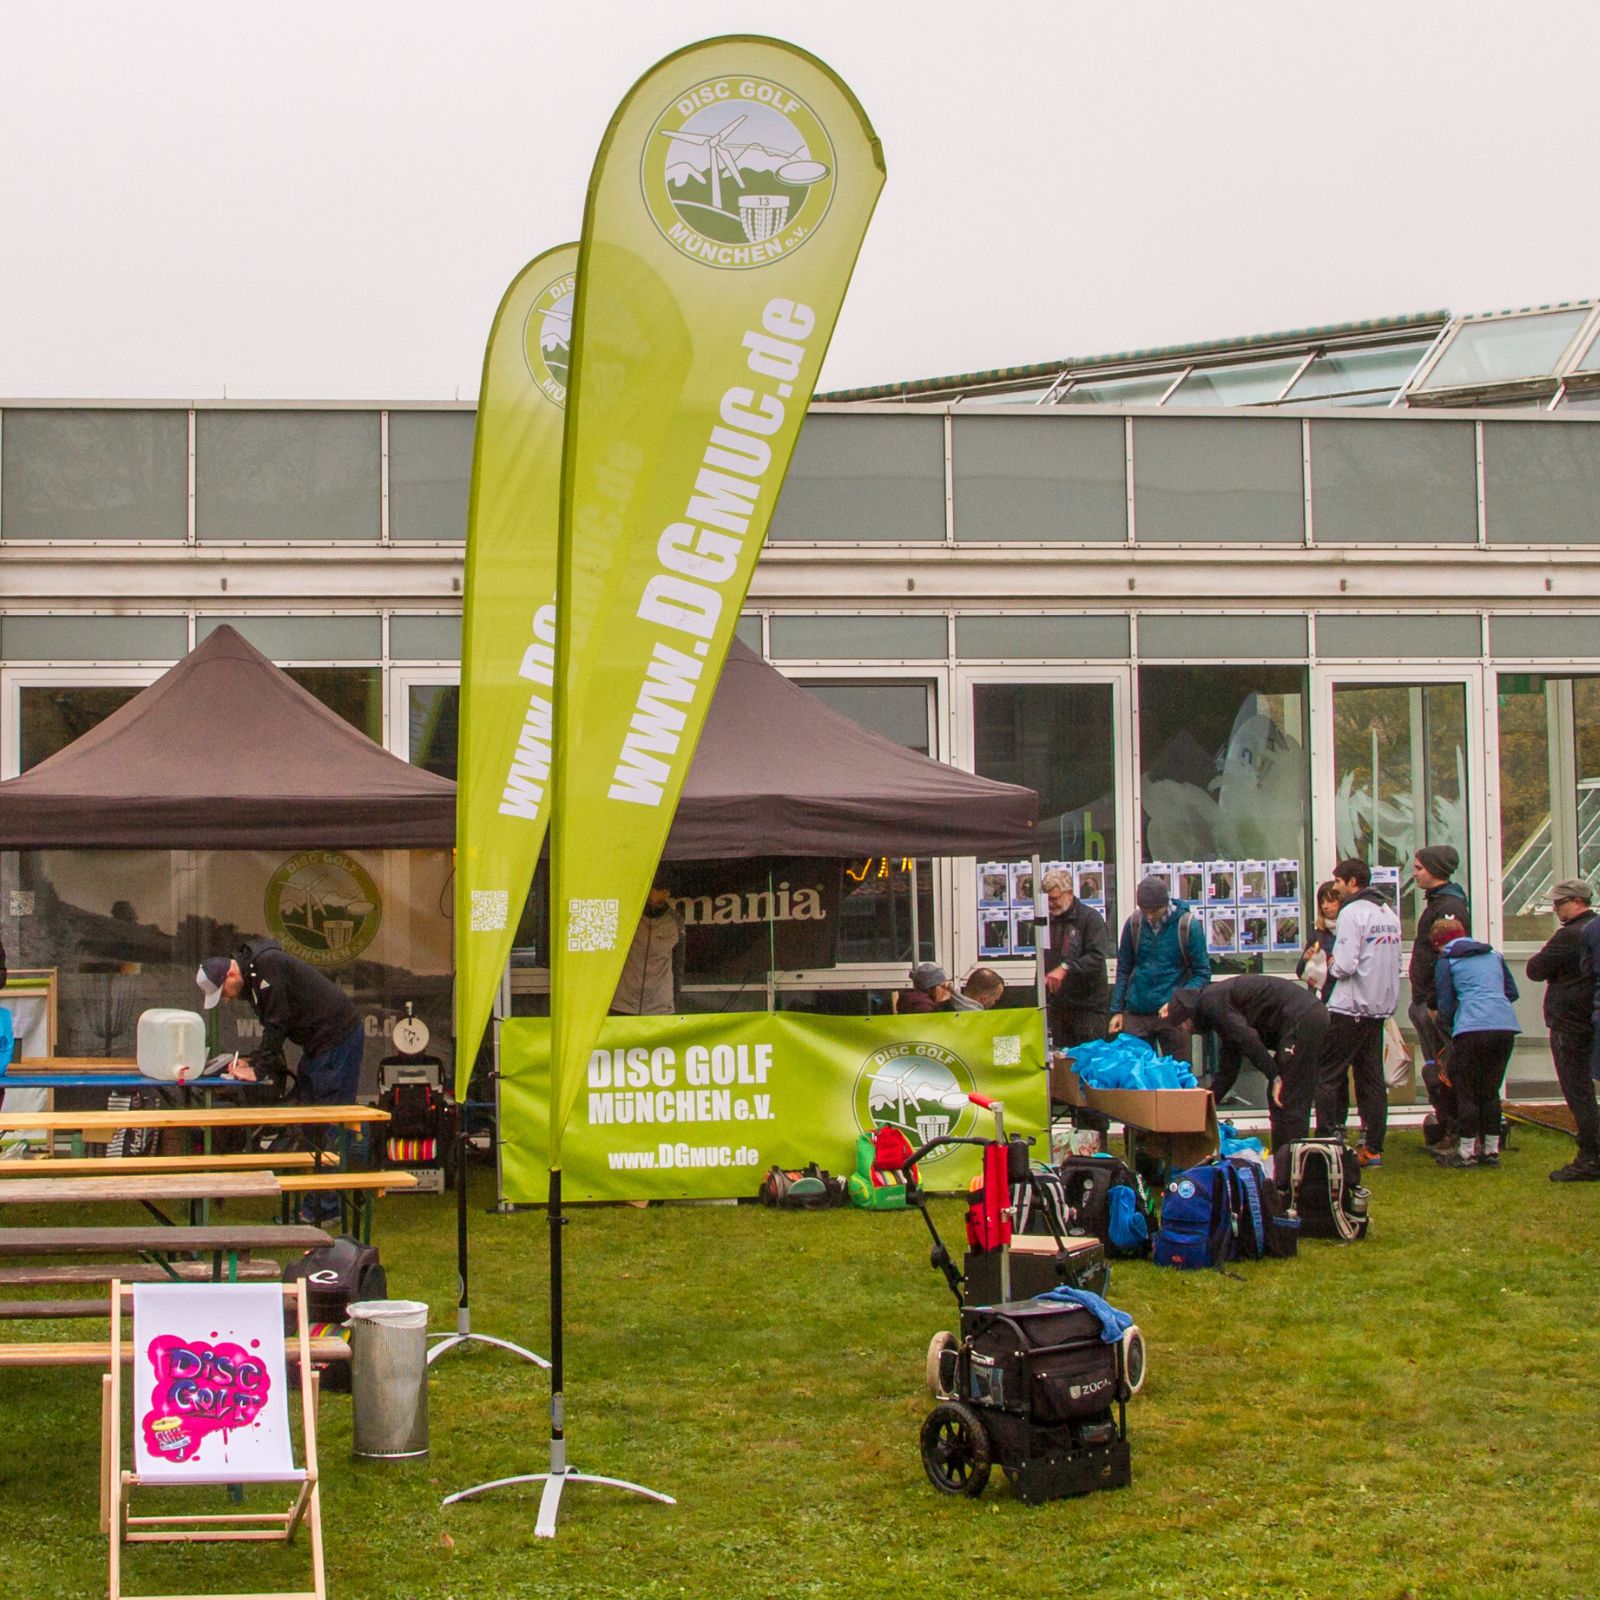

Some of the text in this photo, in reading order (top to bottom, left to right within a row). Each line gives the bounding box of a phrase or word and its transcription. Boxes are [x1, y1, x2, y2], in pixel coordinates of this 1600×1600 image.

[677, 81, 800, 117] DISC GOLF
[758, 196, 770, 207] 13
[668, 221, 783, 265] MÜNCHEN
[549, 277, 577, 300] DIS
[607, 297, 816, 807] www.DGMUC.de
[588, 1043, 773, 1088] DISC GOLF
[874, 1045, 957, 1066] DISC GOLF
[734, 1093, 776, 1121] e.V.
